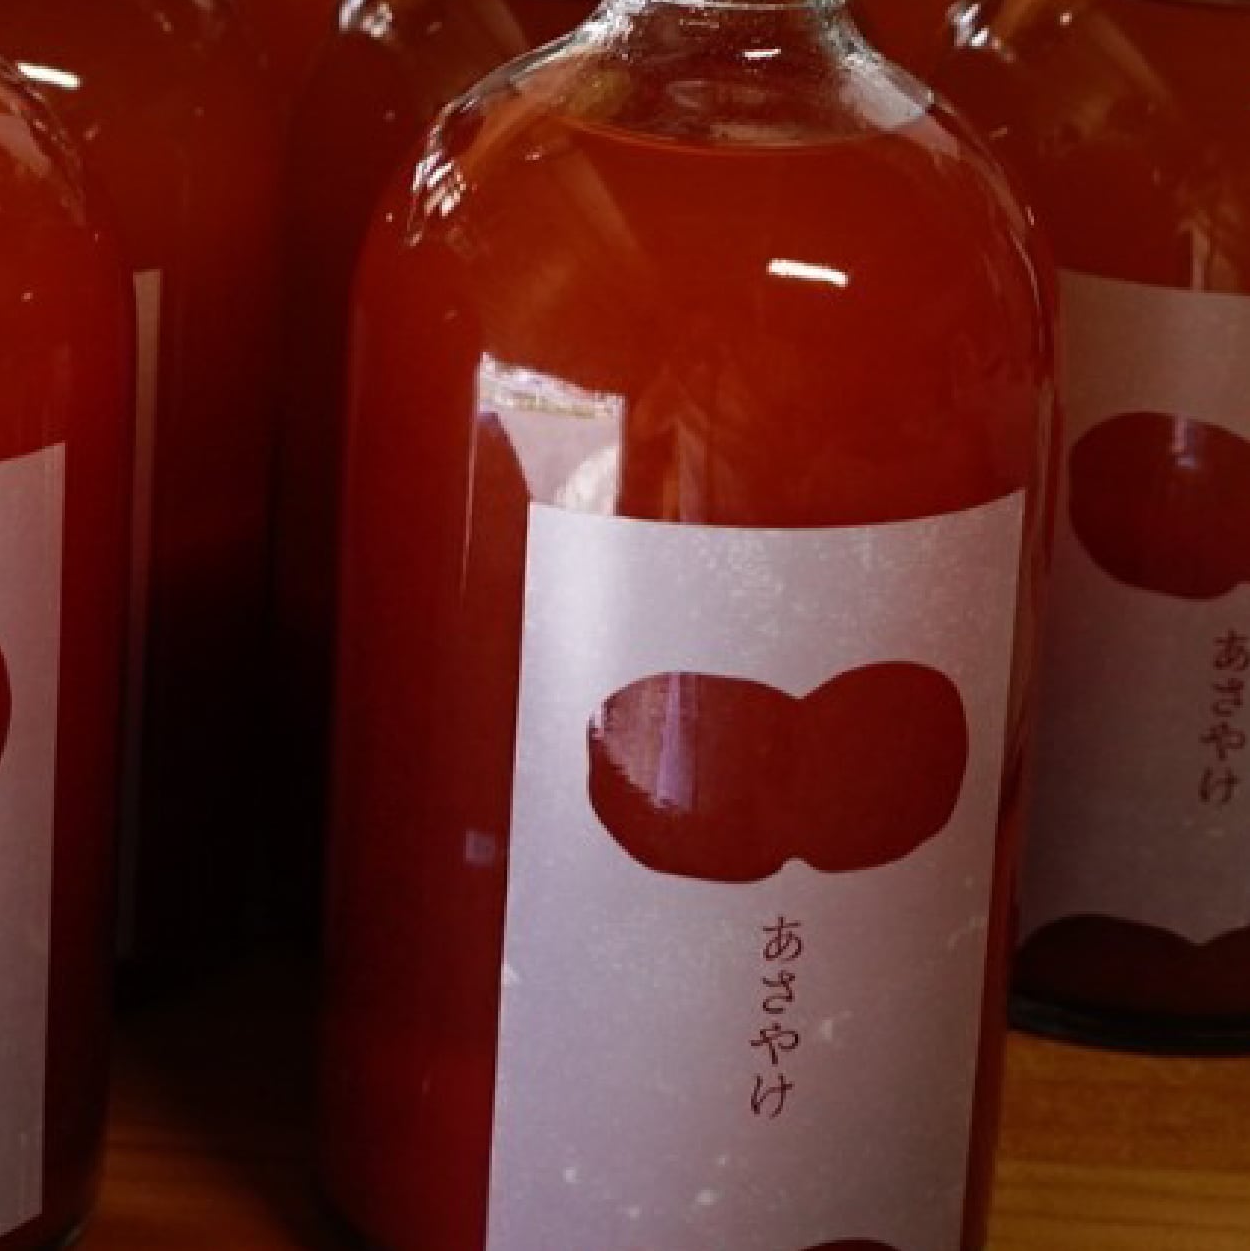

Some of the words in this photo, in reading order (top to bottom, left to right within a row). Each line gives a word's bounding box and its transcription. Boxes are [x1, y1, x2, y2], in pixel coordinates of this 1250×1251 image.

[1199, 629, 1249, 803] あさやけ
[750, 916, 802, 1119] あさやけ
